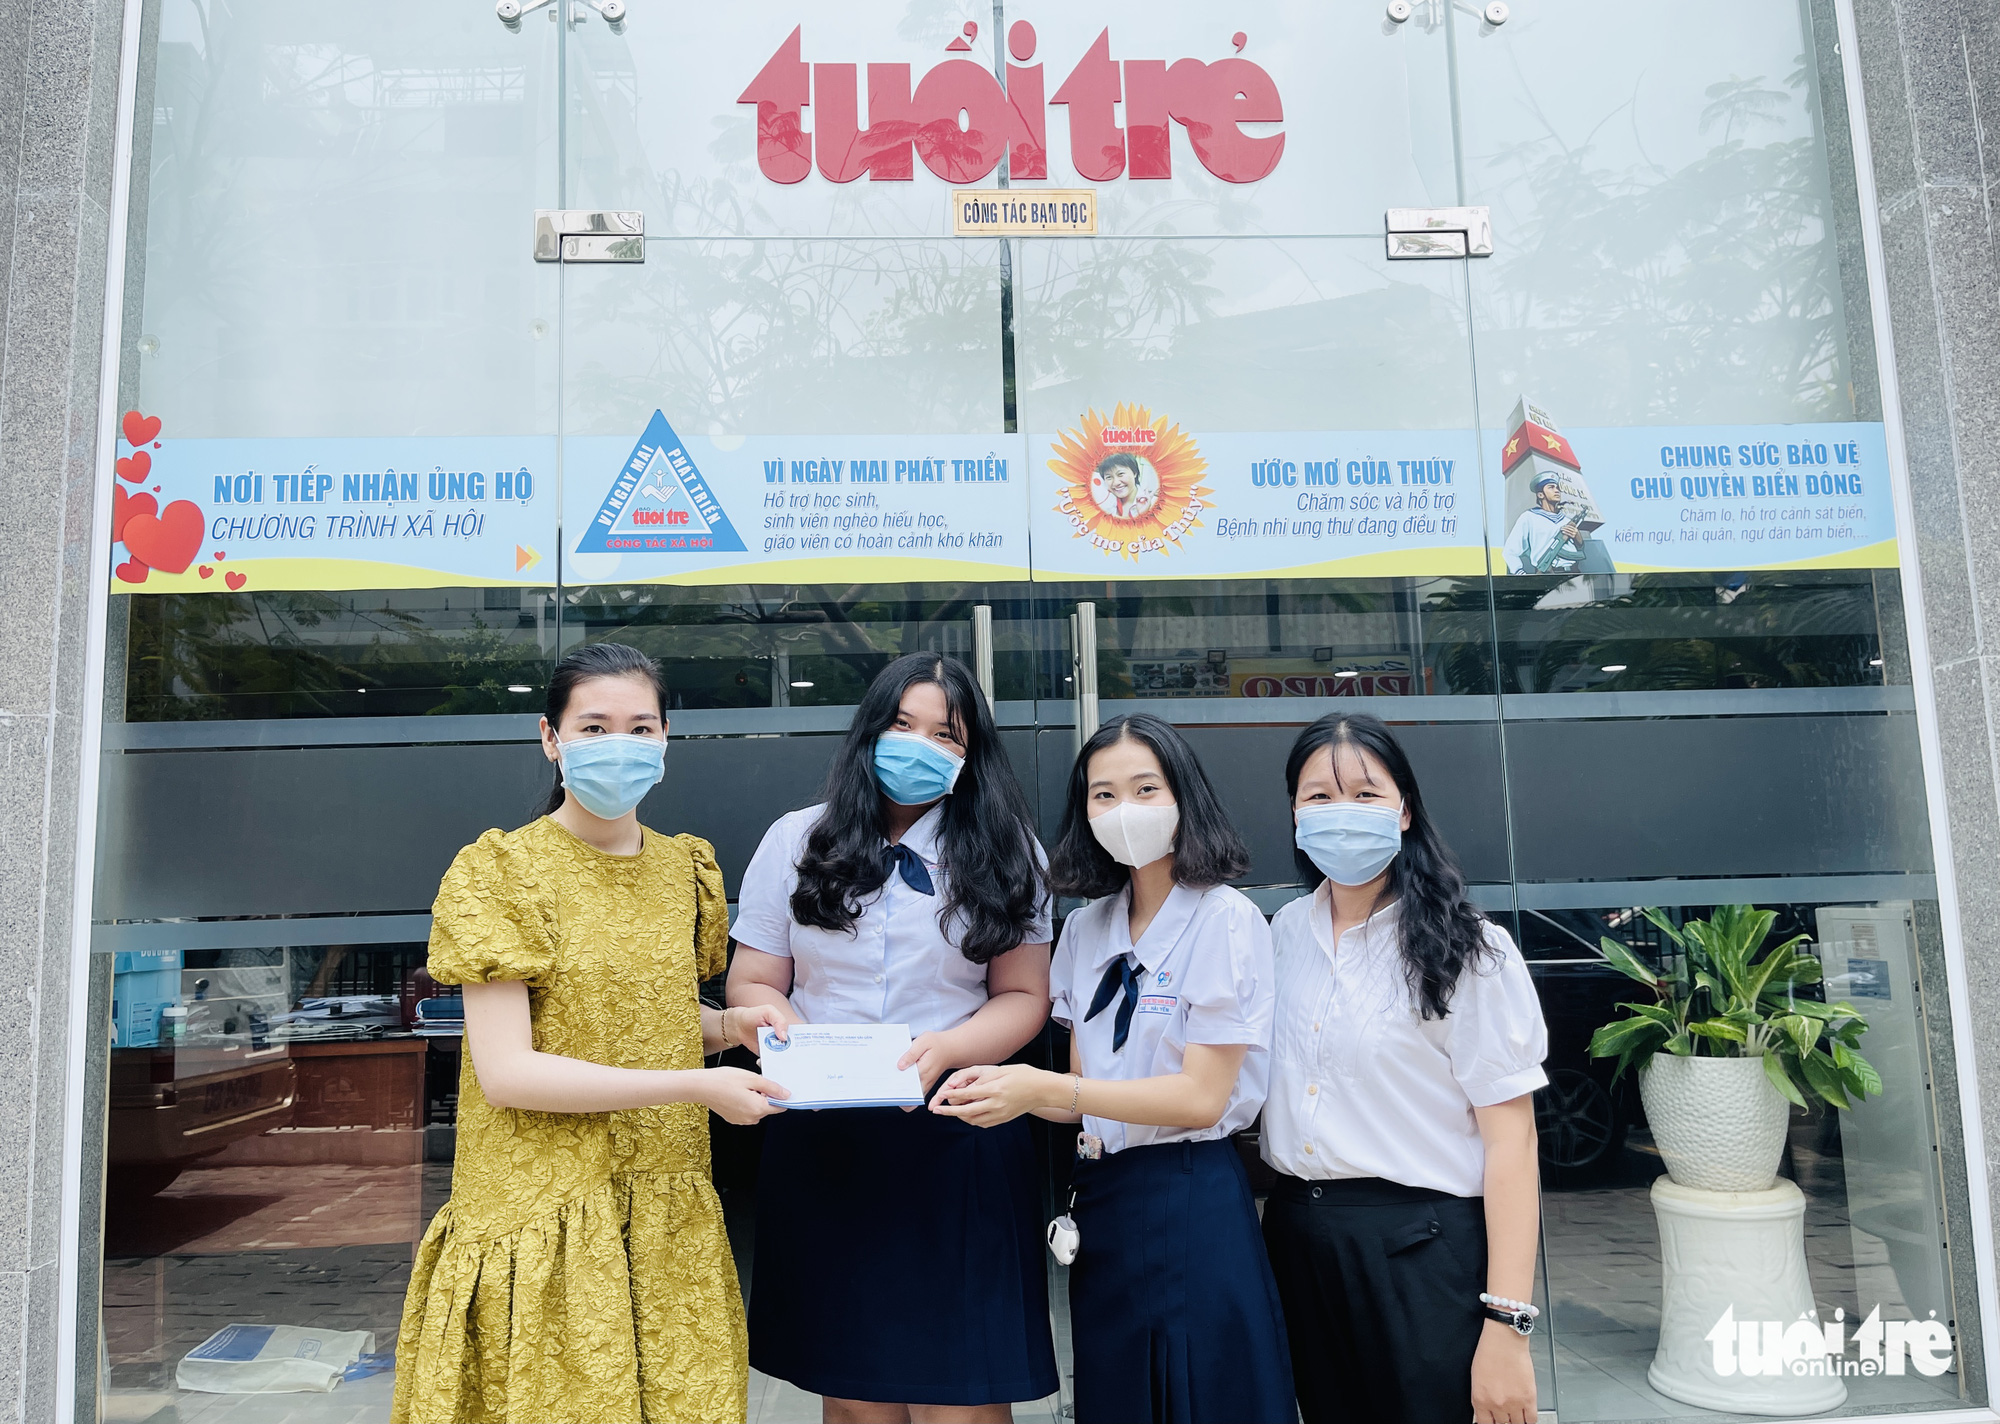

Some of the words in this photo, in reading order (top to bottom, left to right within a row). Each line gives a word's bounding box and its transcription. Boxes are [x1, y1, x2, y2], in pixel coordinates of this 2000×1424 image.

[736, 20, 1047, 183] tuổi
[1049, 25, 1285, 183] trẻ
[964, 198, 998, 223] CÔNG
[1002, 198, 1027, 223] TÁC
[1031, 203, 1057, 229] BẠN
[1062, 203, 1087, 229] ĐỌC
[763, 457, 784, 482] VÌ
[791, 457, 844, 483] NGÀY
[850, 460, 887, 482] MAI
[895, 456, 945, 482] PHÁT
[951, 452, 1007, 482] TRIỂN
[1660, 446, 1732, 468] CHUNG
[1738, 441, 1780, 466] SỨC
[1787, 439, 1828, 465] BẢO
[1833, 440, 1860, 469] VỆ
[214, 471, 262, 503] NƠI
[273, 464, 333, 502] TIẾP
[342, 468, 418, 506] NHẬN
[428, 465, 485, 500] ỦNG
[495, 467, 533, 505] HỘ
[598, 510, 616, 527] VÌ
[608, 472, 638, 510] NGÀY
[630, 443, 654, 473] MAI
[1251, 457, 1297, 487] ƯỚC
[1304, 457, 1340, 486] MƠ
[1346, 455, 1392, 486] CỦA
[1397, 456, 1455, 485] THÚY
[1630, 472, 1673, 499] CHỦ
[1680, 469, 1746, 500] QUYỀN
[1752, 467, 1799, 497] BIỂN
[1805, 470, 1862, 496] ĐÔNG
[667, 448, 697, 483] PHÁT
[689, 483, 721, 525] TRIỂN
[764, 490, 785, 508] Hỗ
[789, 493, 809, 511] trợ
[813, 492, 840, 510] học
[845, 492, 879, 509] sinh,
[1297, 491, 1344, 511] Chăm
[1350, 491, 1379, 511] sóc
[1385, 492, 1402, 509] và
[1408, 488, 1429, 509] hỗ
[1433, 491, 1455, 512] trợ
[211, 513, 316, 540] CHƯƠNG
[326, 510, 398, 538] TRÌNH
[403, 509, 435, 537] XÃ
[442, 509, 485, 540] HỘI
[764, 513, 794, 529] sinh
[800, 513, 828, 529] viên
[833, 512, 877, 531] nghèo
[882, 510, 913, 528] hiếu
[917, 512, 948, 530] học,
[1216, 518, 1257, 539] Bệnh
[1262, 517, 1287, 536] nhi
[1292, 520, 1322, 538] ung
[1327, 517, 1353, 535] thư
[1358, 517, 1398, 537] đang
[1402, 514, 1436, 534] điều
[1441, 514, 1457, 537] trị
[1680, 507, 1717, 522] Chăm
[1720, 507, 1735, 523] lo,
[1740, 505, 1756, 521] hỗ
[1760, 507, 1777, 523] trợ
[1781, 505, 1811, 520] cảnh
[1815, 505, 1833, 520] sát
[1838, 503, 1867, 521] biển,
[606, 537, 641, 549] CÔNG
[645, 537, 667, 548] TÁC
[670, 536, 686, 548] XÃ
[690, 536, 713, 549] HỘI
[764, 534, 795, 552] giáo
[800, 533, 829, 549] viên
[834, 533, 852, 549] có
[856, 533, 892, 548] hoàn
[898, 531, 932, 548] cảnh
[937, 532, 964, 547] khó
[968, 531, 1003, 547] khăn
[1614, 526, 1644, 543] kiểm
[1648, 529, 1674, 545] ngư,
[1680, 526, 1698, 541] hải
[1702, 527, 1736, 543] quân,
[1741, 528, 1765, 543] ngư
[1769, 526, 1794, 540] dân
[1796, 526, 1823, 540] bám
